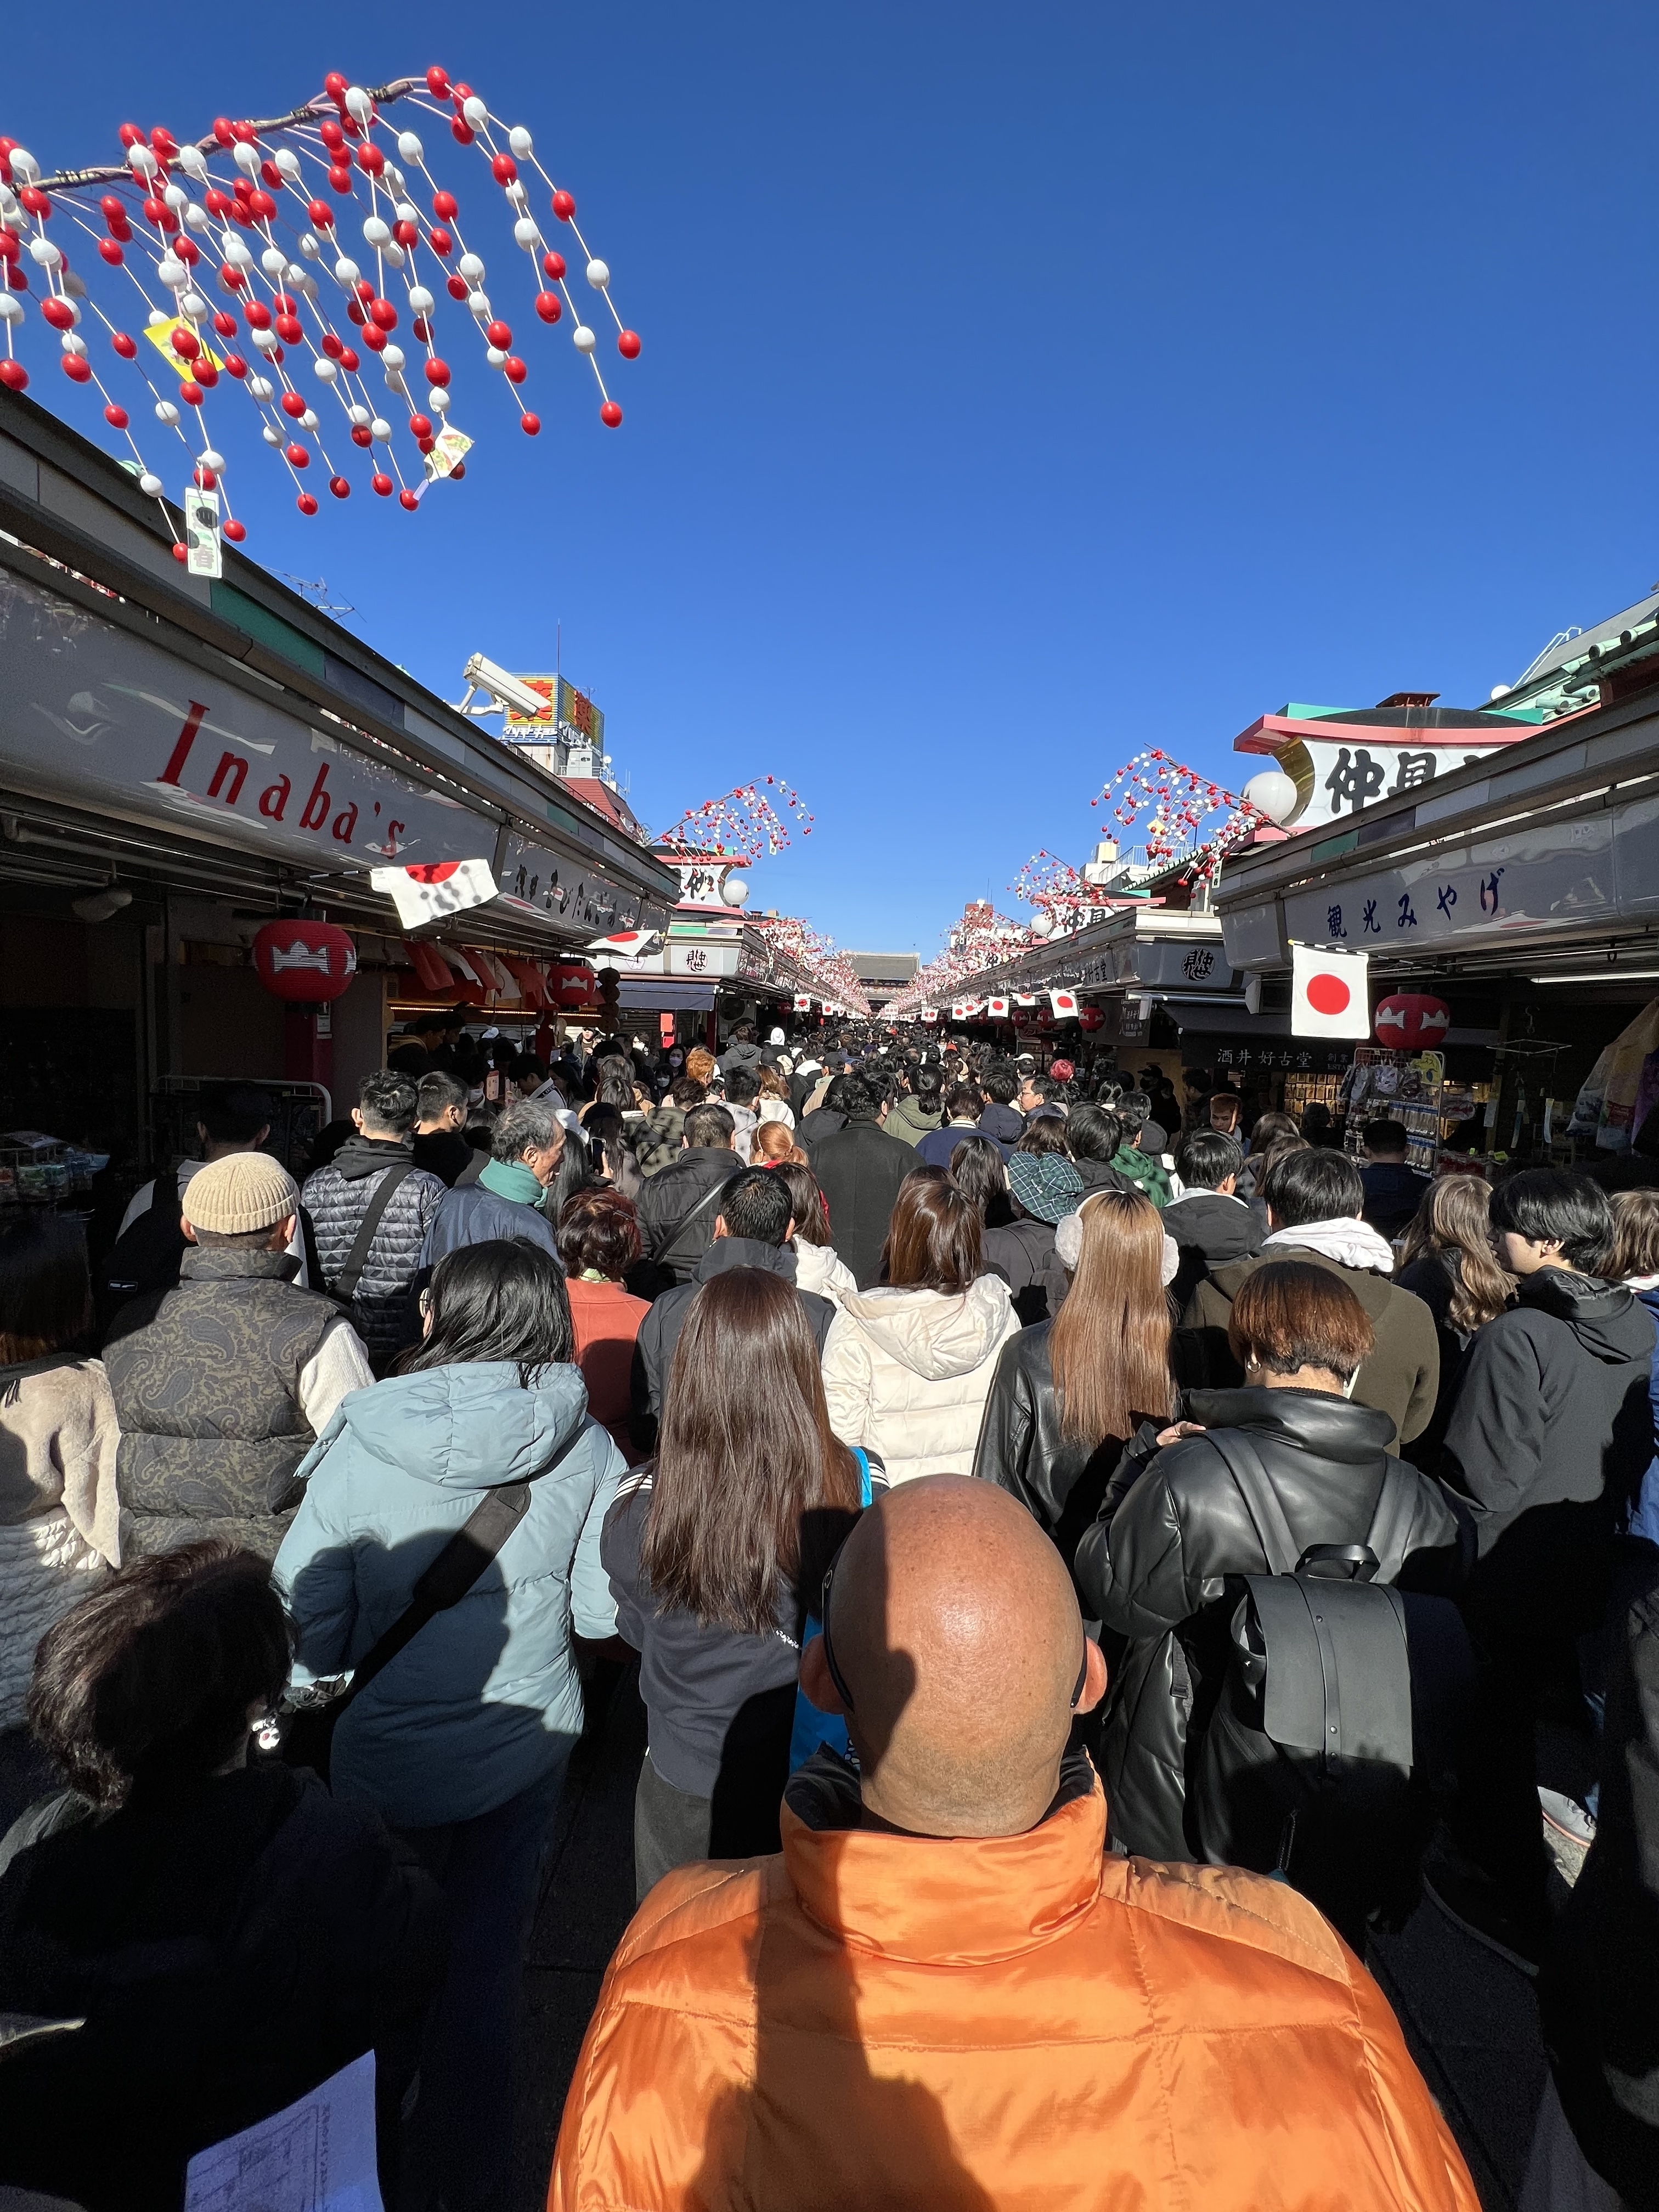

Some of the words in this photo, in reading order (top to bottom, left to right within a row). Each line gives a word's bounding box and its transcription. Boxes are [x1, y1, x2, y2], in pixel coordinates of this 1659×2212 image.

[574, 690, 591, 736] 薬
[156, 699, 405, 860] Inaba's
[1325, 747, 1480, 814] 仲見
[1328, 868, 1505, 938] 観光みやげ
[1217, 1048, 1252, 1065] 酒井
[1258, 1051, 1312, 1068] 好古堂
